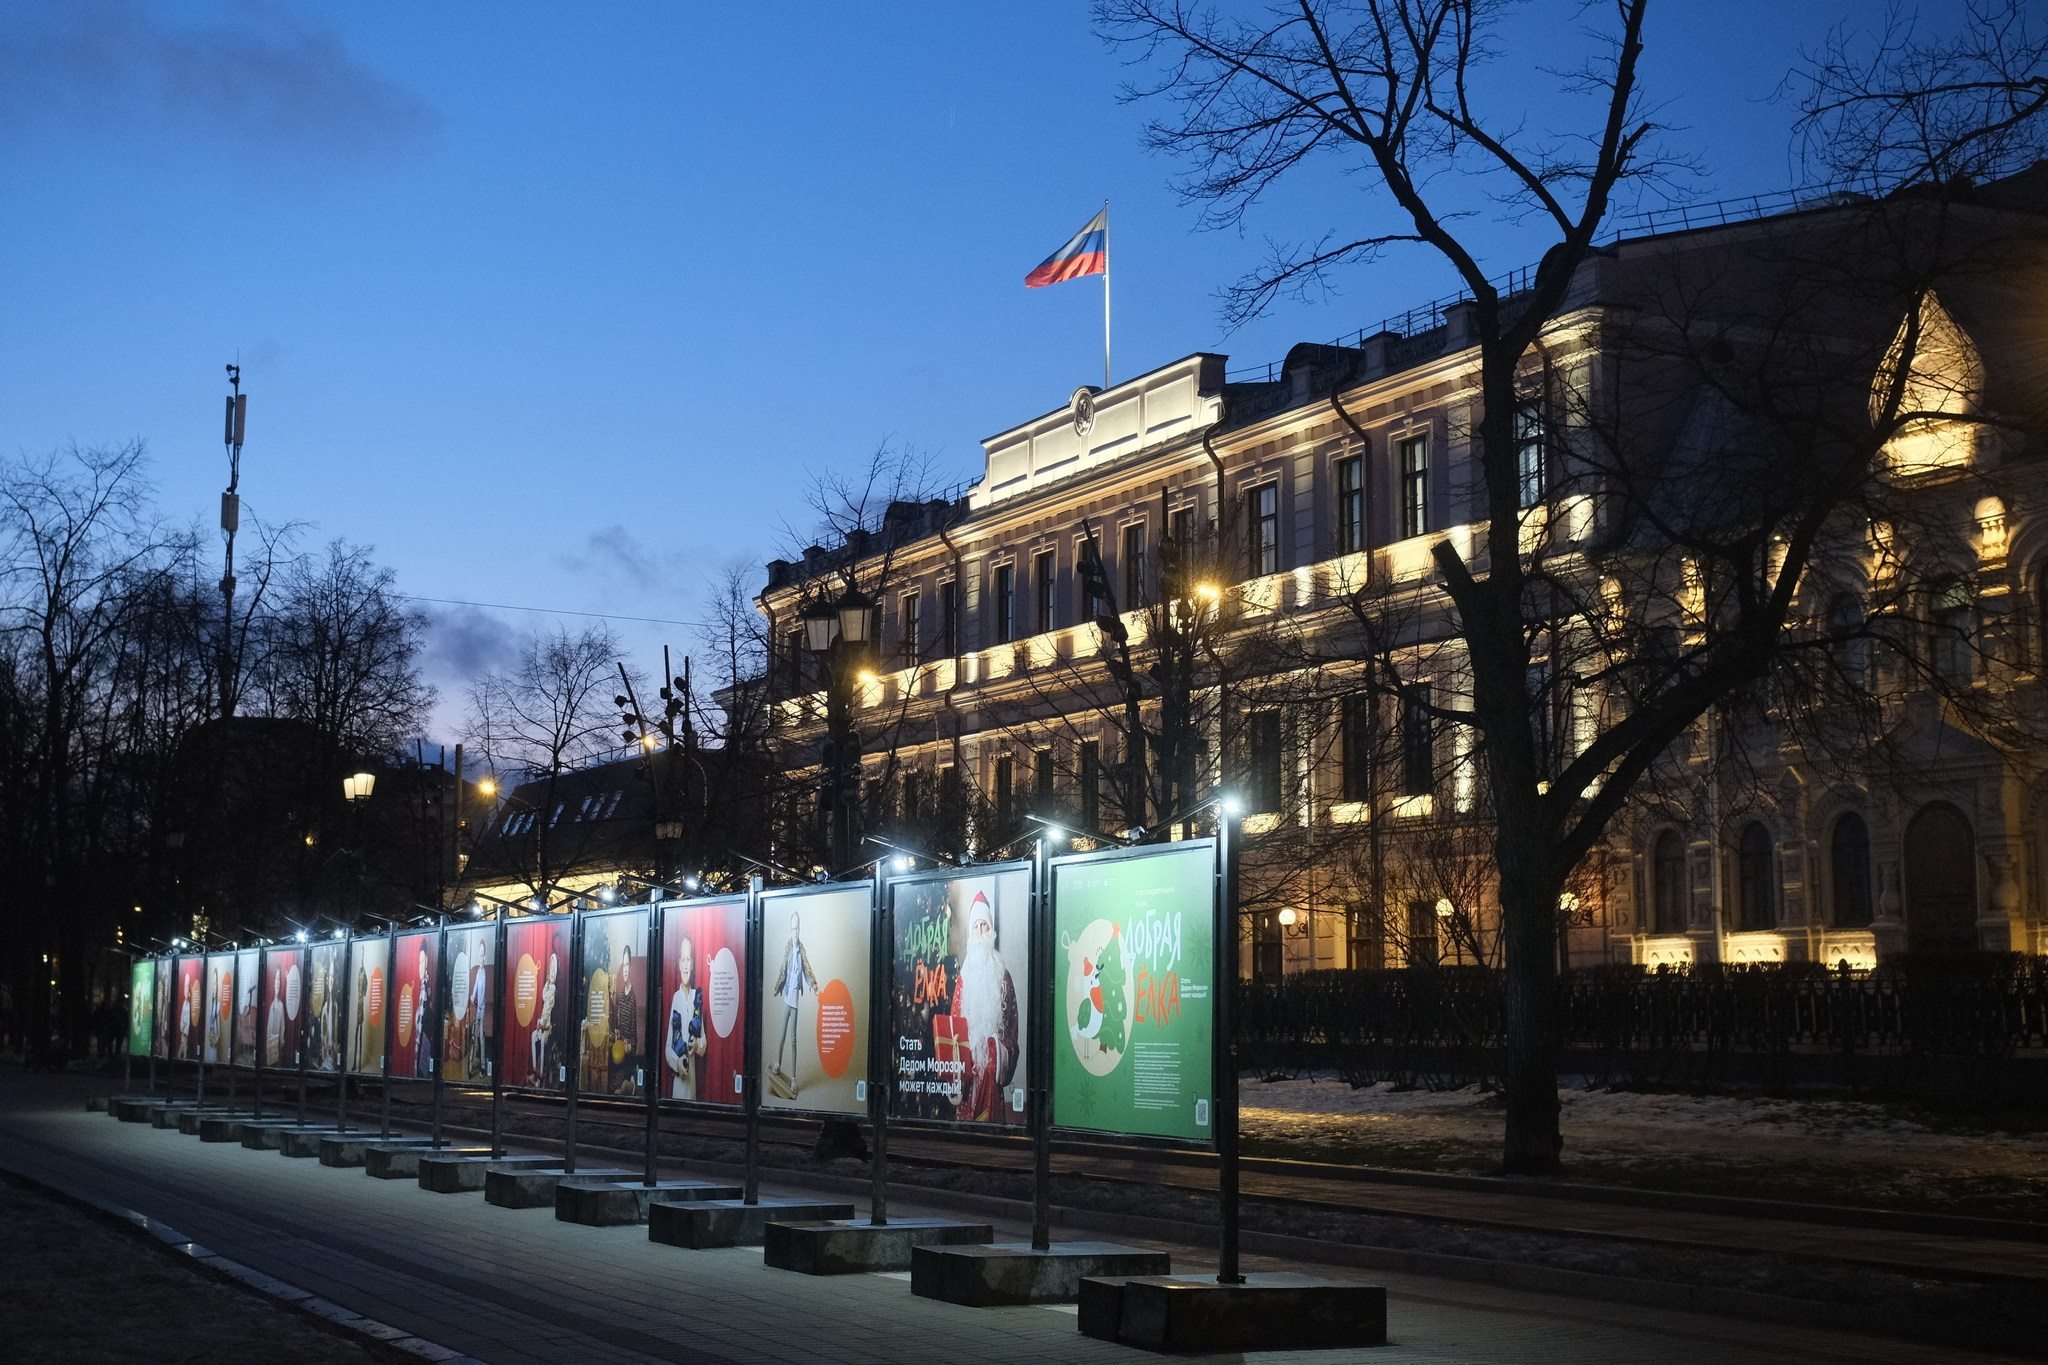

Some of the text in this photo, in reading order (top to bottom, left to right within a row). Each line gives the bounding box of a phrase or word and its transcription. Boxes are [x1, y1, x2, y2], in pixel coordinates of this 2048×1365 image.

[904, 915, 948, 970] ДОБРАЯ
[1119, 908, 1181, 972] ДОБРАЯ
[913, 960, 947, 1006] ЁЛКА
[1135, 963, 1180, 1028] ЁЛКА
[900, 1035, 923, 1051] Стать
[898, 1057, 966, 1077] Дедом Морозом
[899, 1079, 962, 1097] может каждый!
